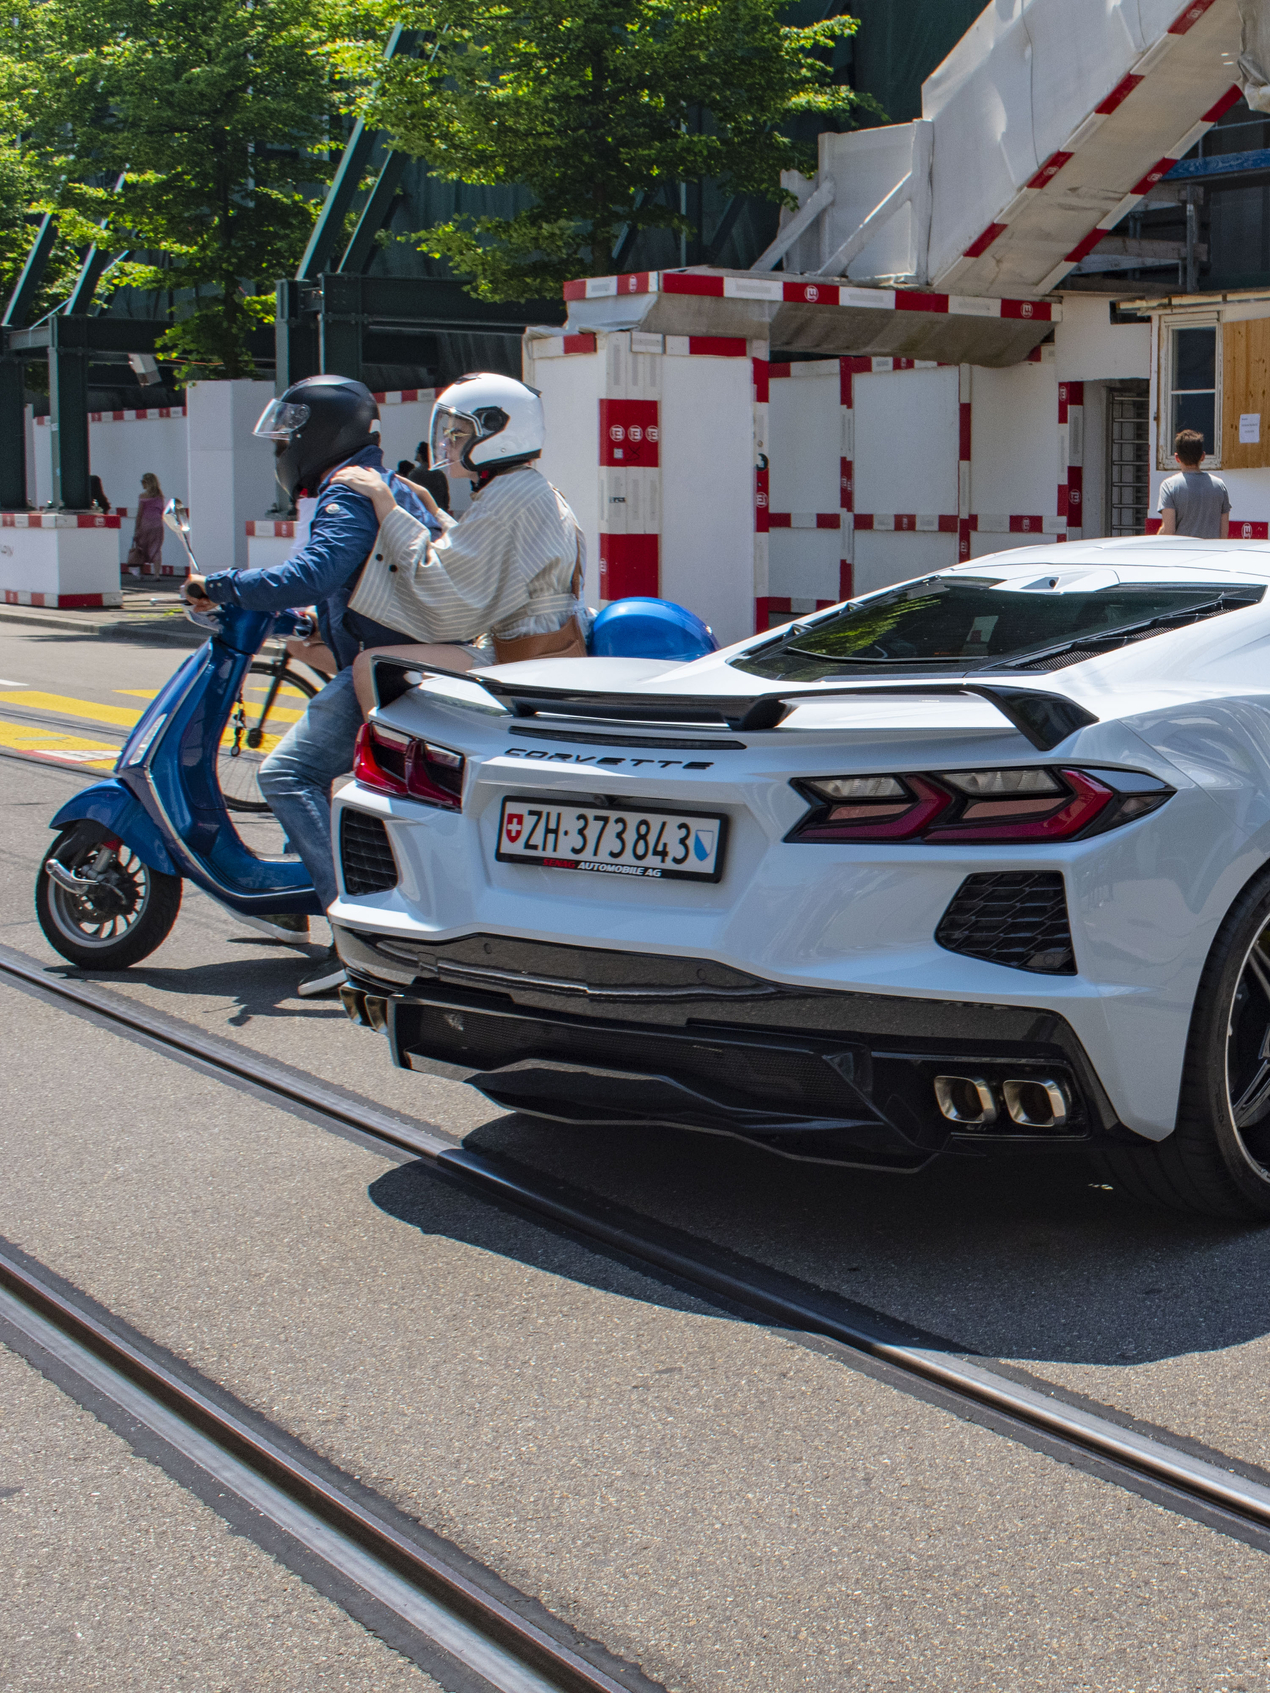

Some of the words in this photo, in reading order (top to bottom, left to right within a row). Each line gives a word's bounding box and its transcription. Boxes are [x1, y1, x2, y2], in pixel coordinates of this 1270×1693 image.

[504, 747, 715, 770] CORVETTE
[543, 858, 576, 869] SENAG
[577, 861, 645, 876] AUTOMOBILE
[645, 867, 662, 878] AG
